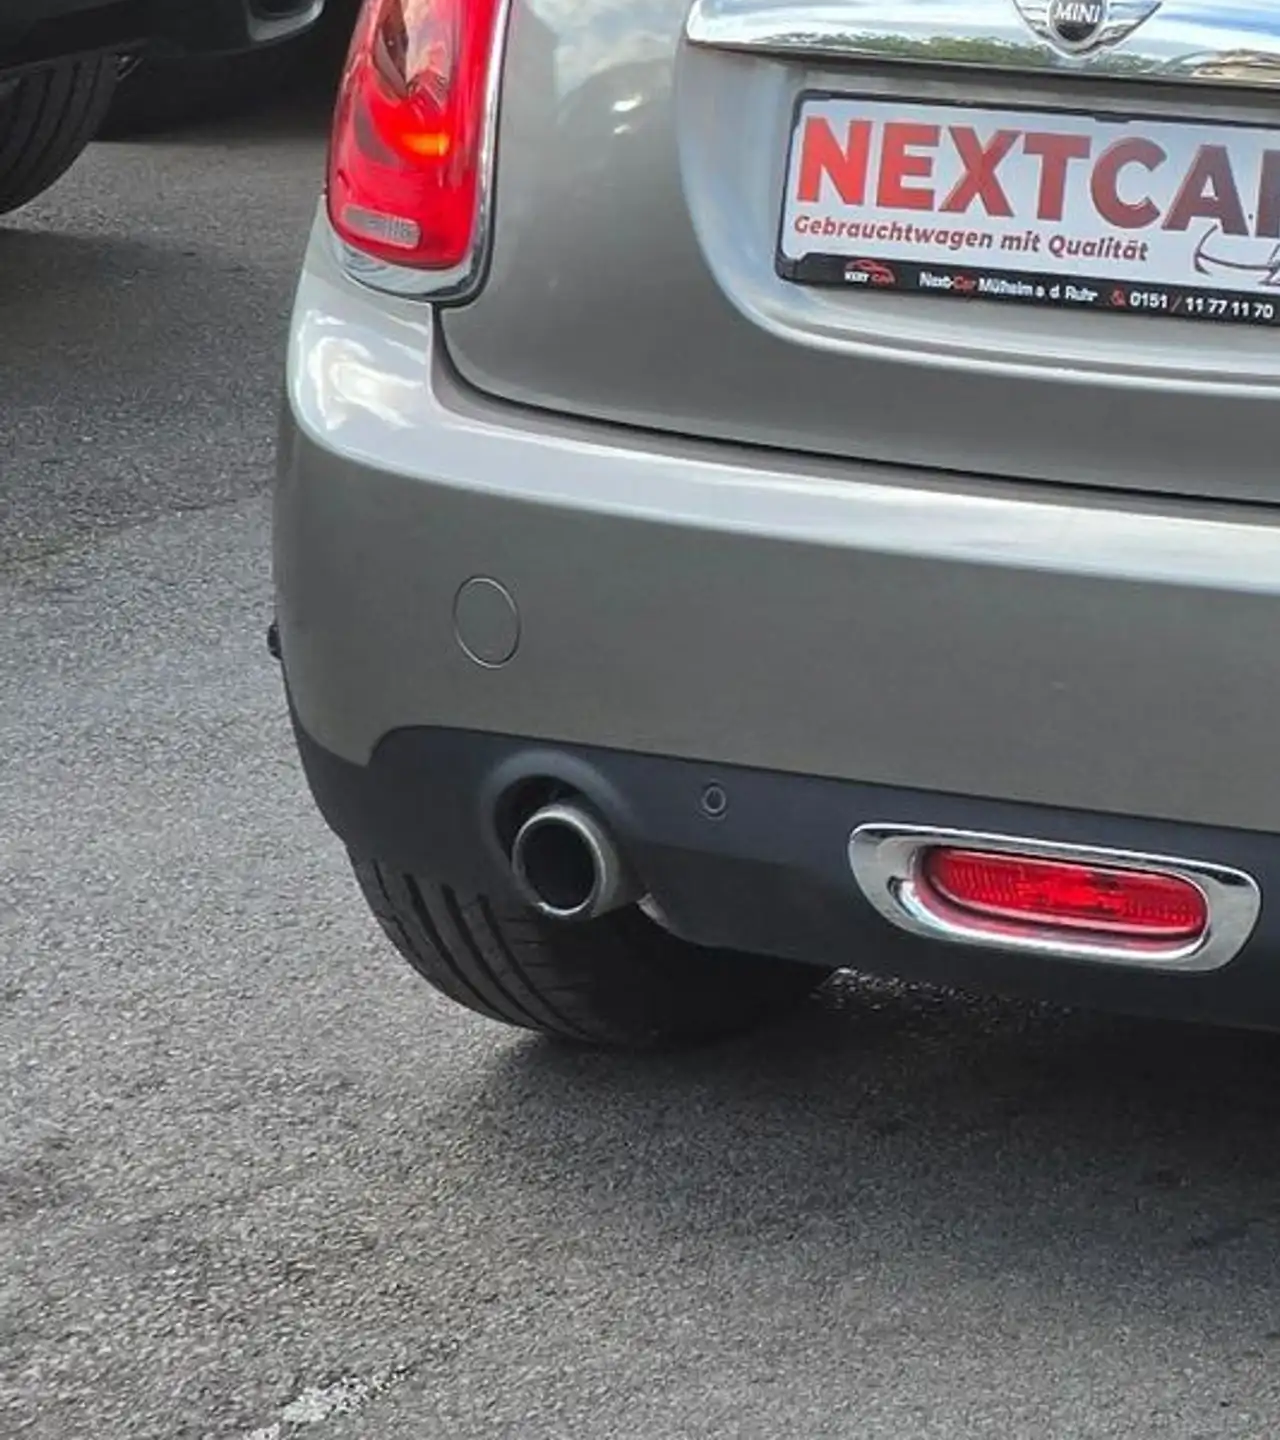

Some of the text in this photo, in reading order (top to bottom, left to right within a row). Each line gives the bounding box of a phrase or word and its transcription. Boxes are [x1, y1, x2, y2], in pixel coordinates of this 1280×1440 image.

[1053, 1, 1100, 23] MINI
[794, 216, 1149, 262] Gebrauchtwagen mit Qualität
[1129, 291, 1168, 308] 0151
[1184, 297, 1203, 311] 11
[1207, 300, 1227, 314] 77
[1231, 303, 1250, 317] 11
[1253, 304, 1274, 319] 70
